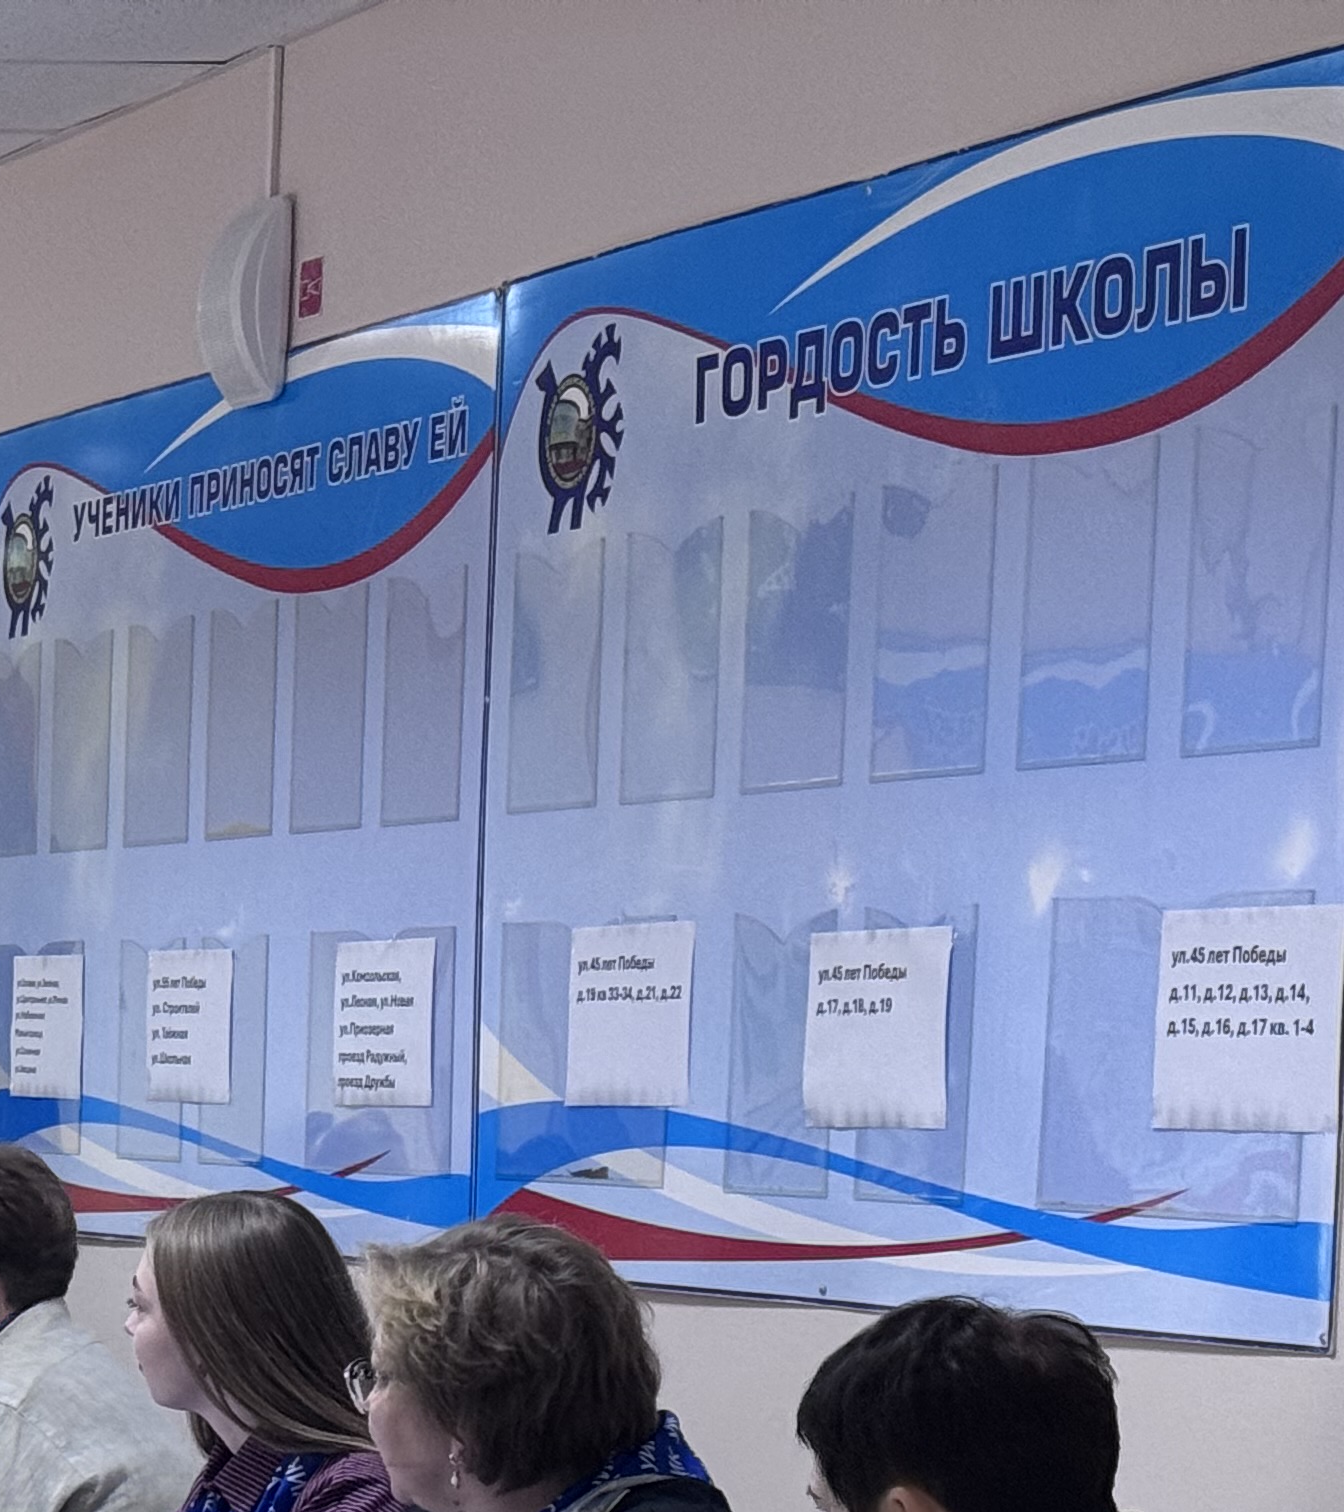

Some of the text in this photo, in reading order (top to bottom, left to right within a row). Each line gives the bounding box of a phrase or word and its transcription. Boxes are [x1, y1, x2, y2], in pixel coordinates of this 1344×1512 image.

[694, 223, 1252, 426] ГОРДОСТЬ ШКОЛЫ
[72, 394, 471, 543] УЧЕНИКИ ПРИНОСЯТ СЛАВУ ЕЙ
[618, 955, 655, 973] Победы
[1207, 948, 1231, 963] лет
[1233, 945, 1287, 967] Победы
[844, 968, 862, 981] лет
[863, 963, 907, 982] Победы
[1168, 983, 1311, 1004] д.11, д.12, д.13, д.14,
[1167, 1017, 1199, 1038] д.15,
[1201, 1017, 1234, 1038] д.16,
[1237, 1018, 1267, 1037] д.17
[1293, 1018, 1315, 1036] 1-4
